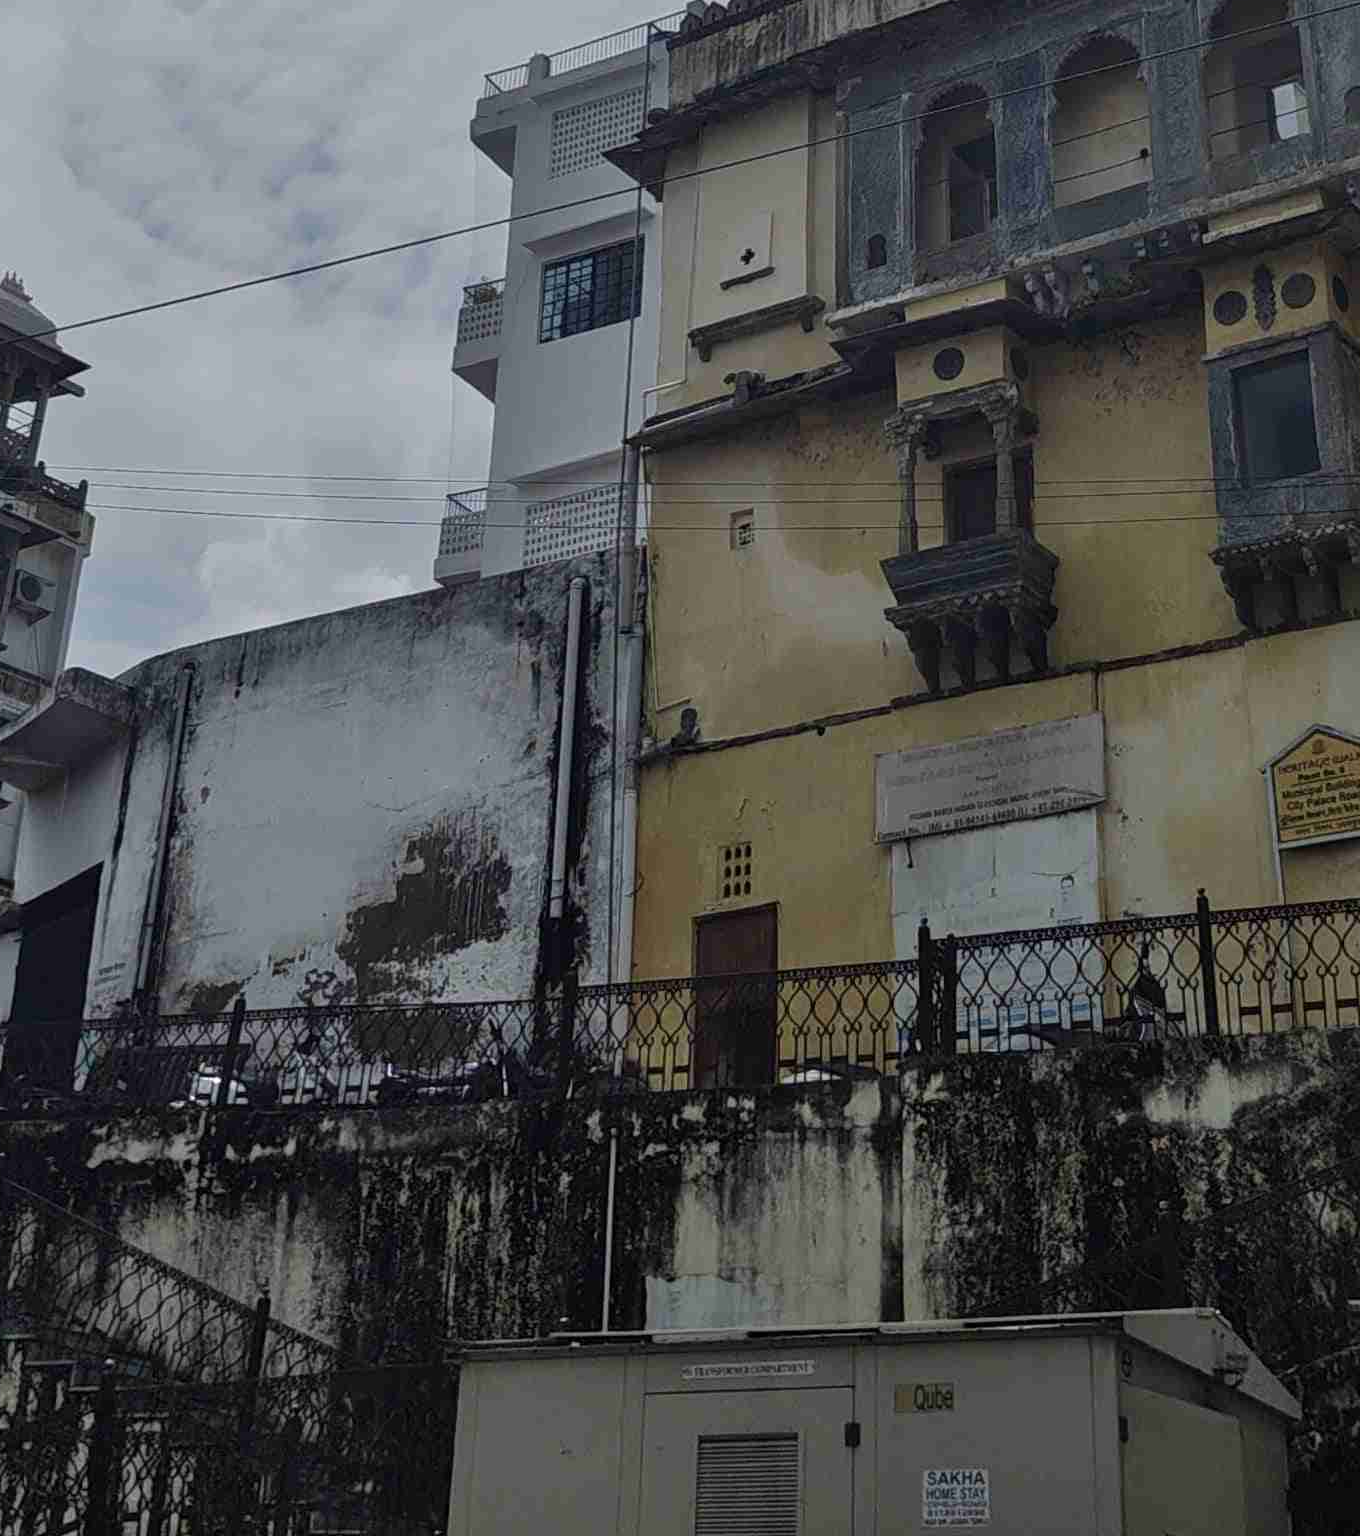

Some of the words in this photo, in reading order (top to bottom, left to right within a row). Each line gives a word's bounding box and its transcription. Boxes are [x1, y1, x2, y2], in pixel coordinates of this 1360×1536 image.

[913, 1383, 954, 1411] Qube
[926, 1471, 985, 1486] SAKHA
[926, 1487, 957, 1500] HOME
[959, 1486, 986, 1500] STAY
